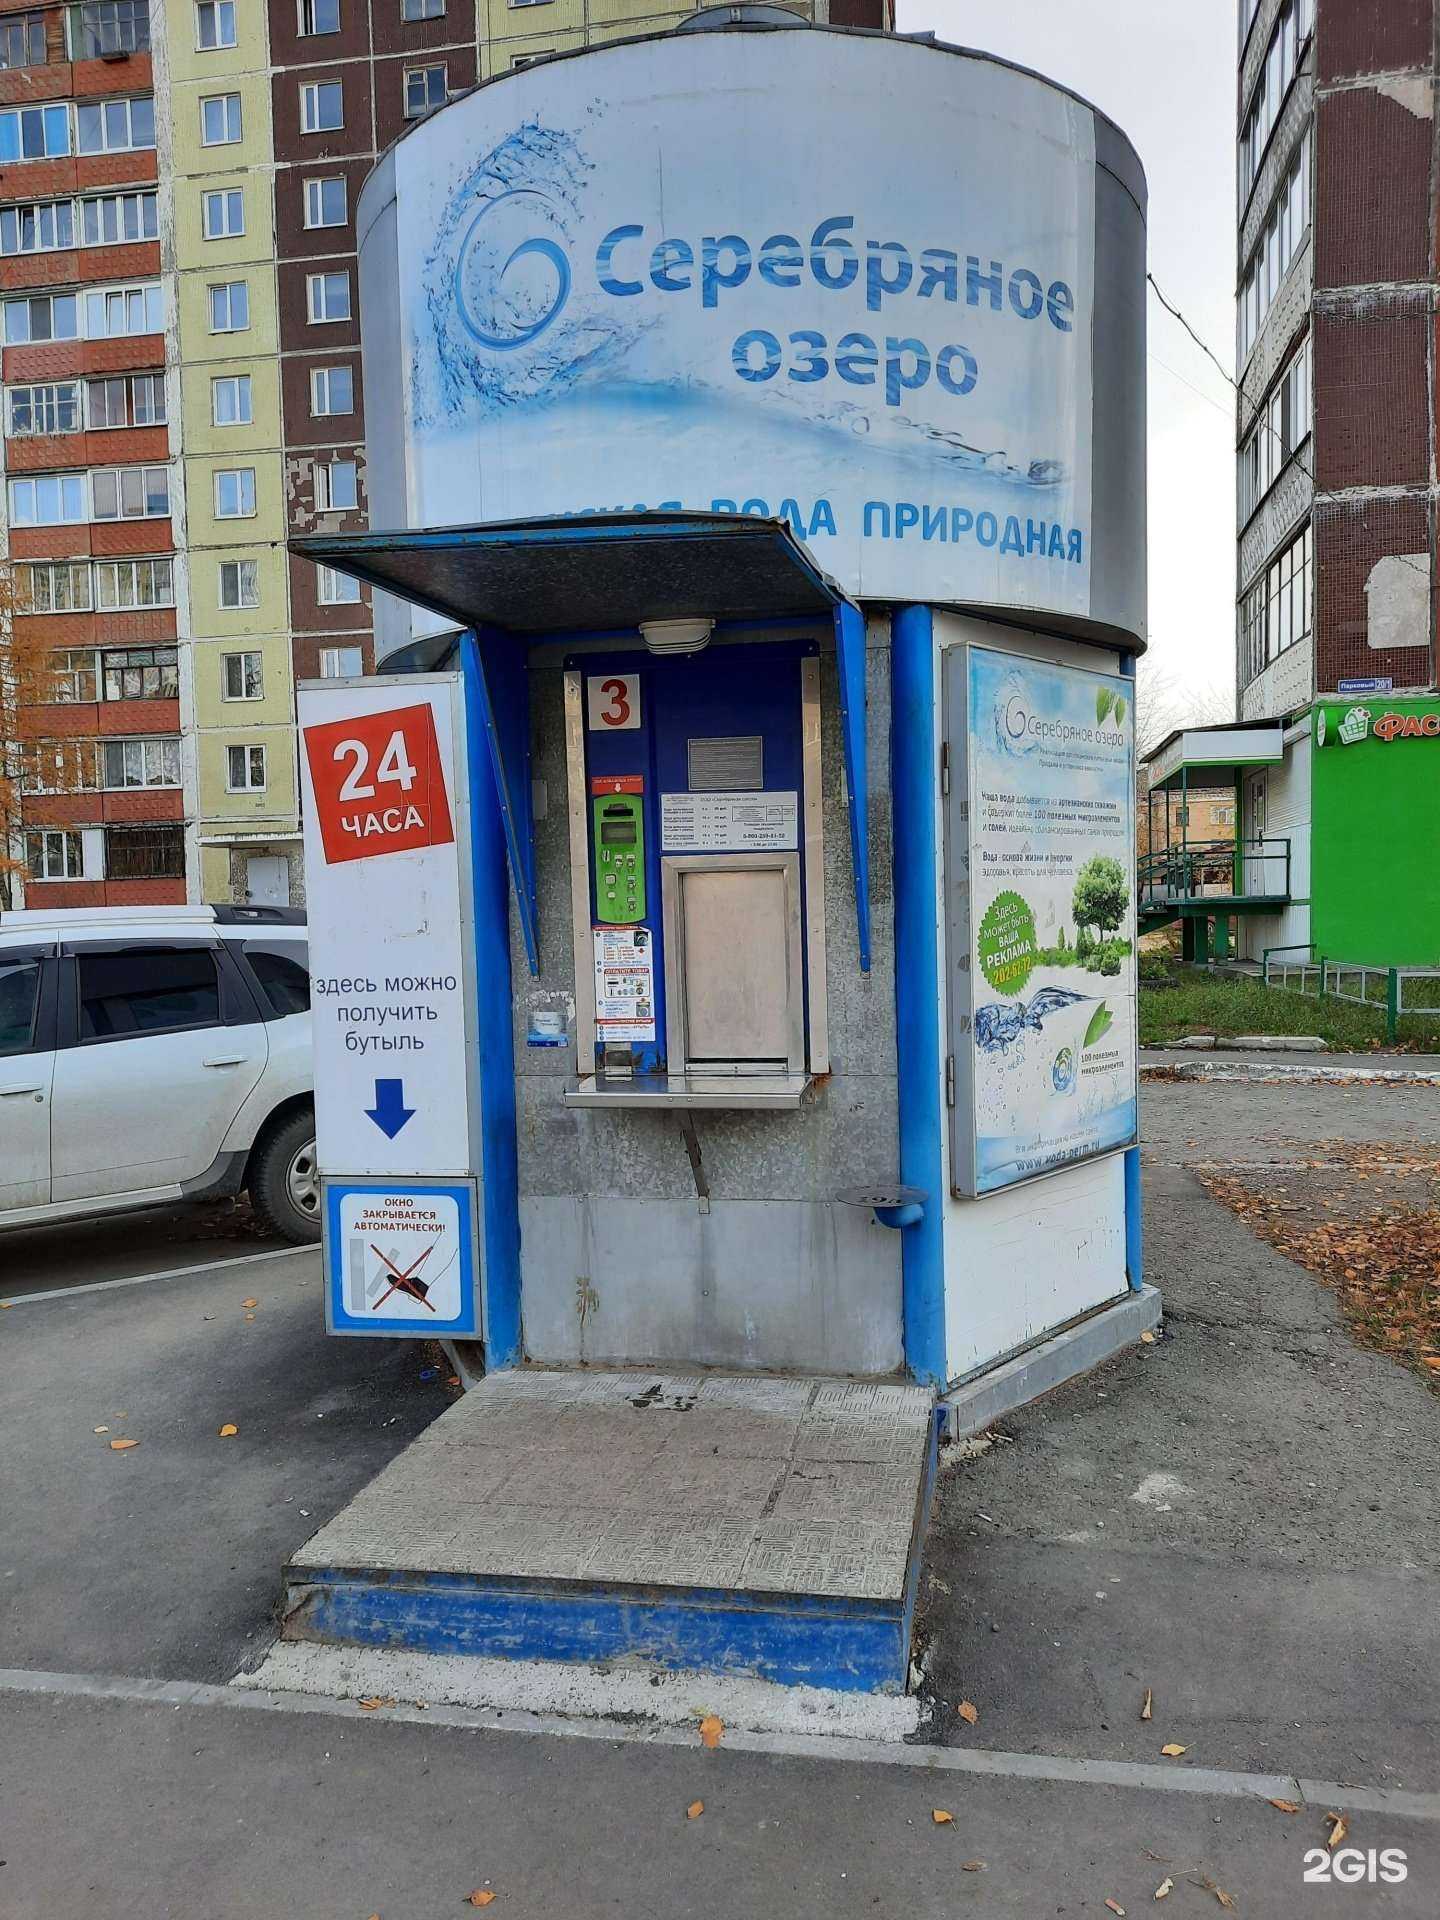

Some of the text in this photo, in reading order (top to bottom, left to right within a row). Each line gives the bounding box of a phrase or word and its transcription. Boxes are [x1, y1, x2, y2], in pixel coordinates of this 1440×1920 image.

[595, 216, 1074, 333] Серебряное
[731, 328, 978, 406] озеро
[863, 500, 1083, 565] ПРИРОДНАЯ
[1376, 679, 1391, 690] 20/1
[600, 678, 630, 726] 3
[1027, 715, 1124, 748] Серебряное озеро
[333, 730, 417, 802] 24
[342, 806, 424, 838] ЧАСА
[982, 851, 998, 863] Вода
[1002, 853, 1023, 862] основа
[998, 930, 1020, 948] ВАША
[986, 940, 1032, 968] РЕКЛАМА
[316, 976, 457, 997] здесь можно
[337, 1006, 438, 1026] получить
[345, 1031, 425, 1055] бутыль
[1016, 1139, 1100, 1172] www.voda-perm.ru
[362, 1209, 436, 1220] ЗАКРЫВАЕТСЯ
[384, 1198, 414, 1207] ОКНО
[354, 1222, 446, 1232] АВТОМАТИЧЕСКИ!
